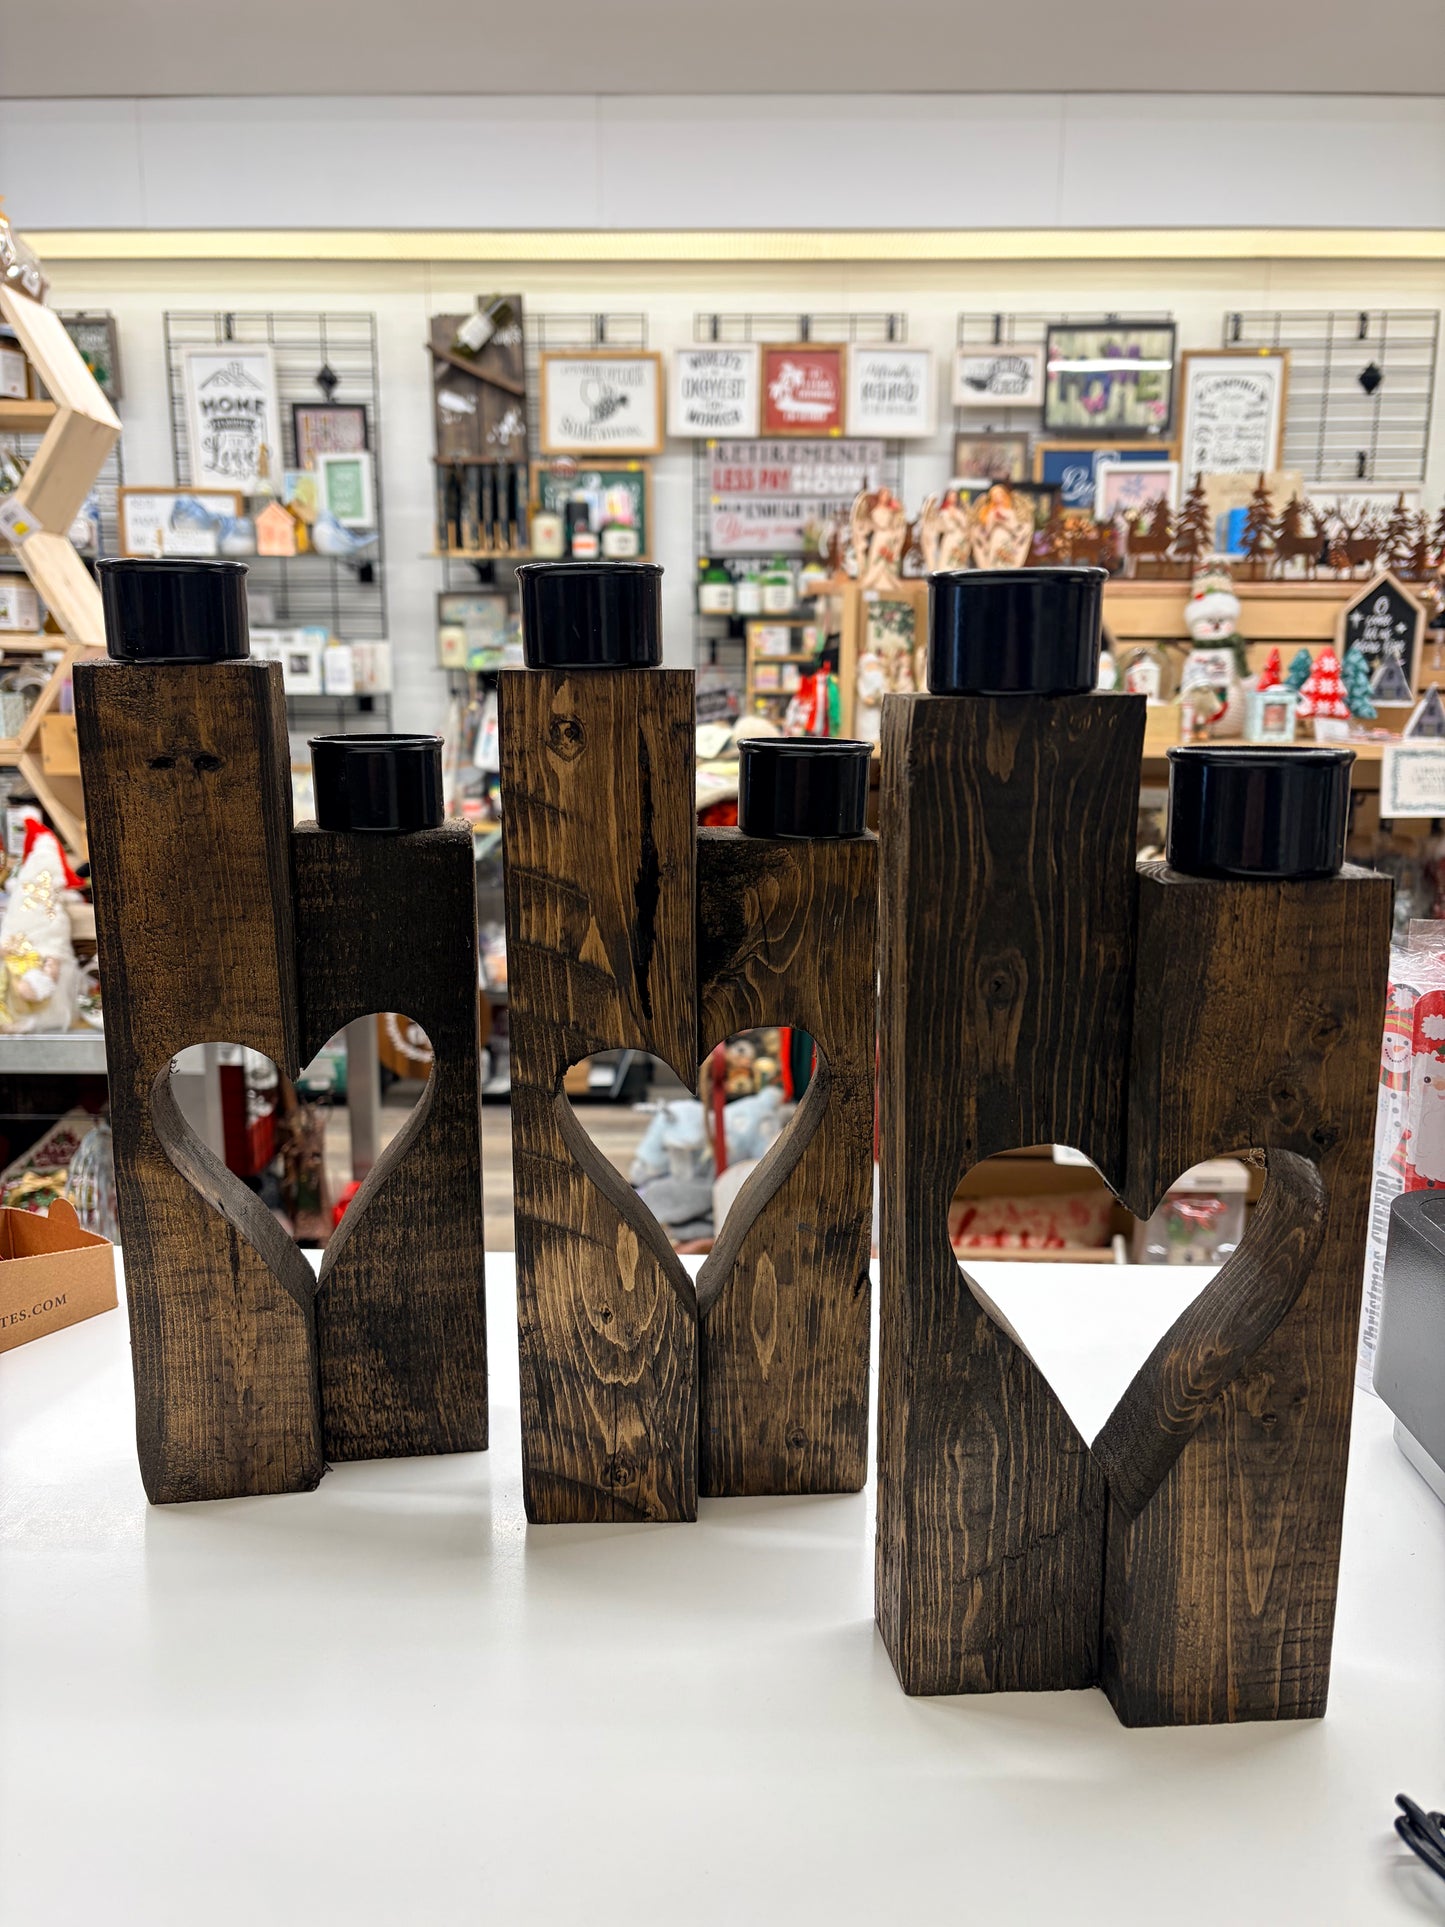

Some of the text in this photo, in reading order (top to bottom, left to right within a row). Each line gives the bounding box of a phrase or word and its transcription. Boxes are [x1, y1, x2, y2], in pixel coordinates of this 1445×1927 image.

[202, 399, 265, 416] HOME
[713, 468, 752, 492] LESS
[1362, 1170, 1404, 1351] Christmas CHEER!
